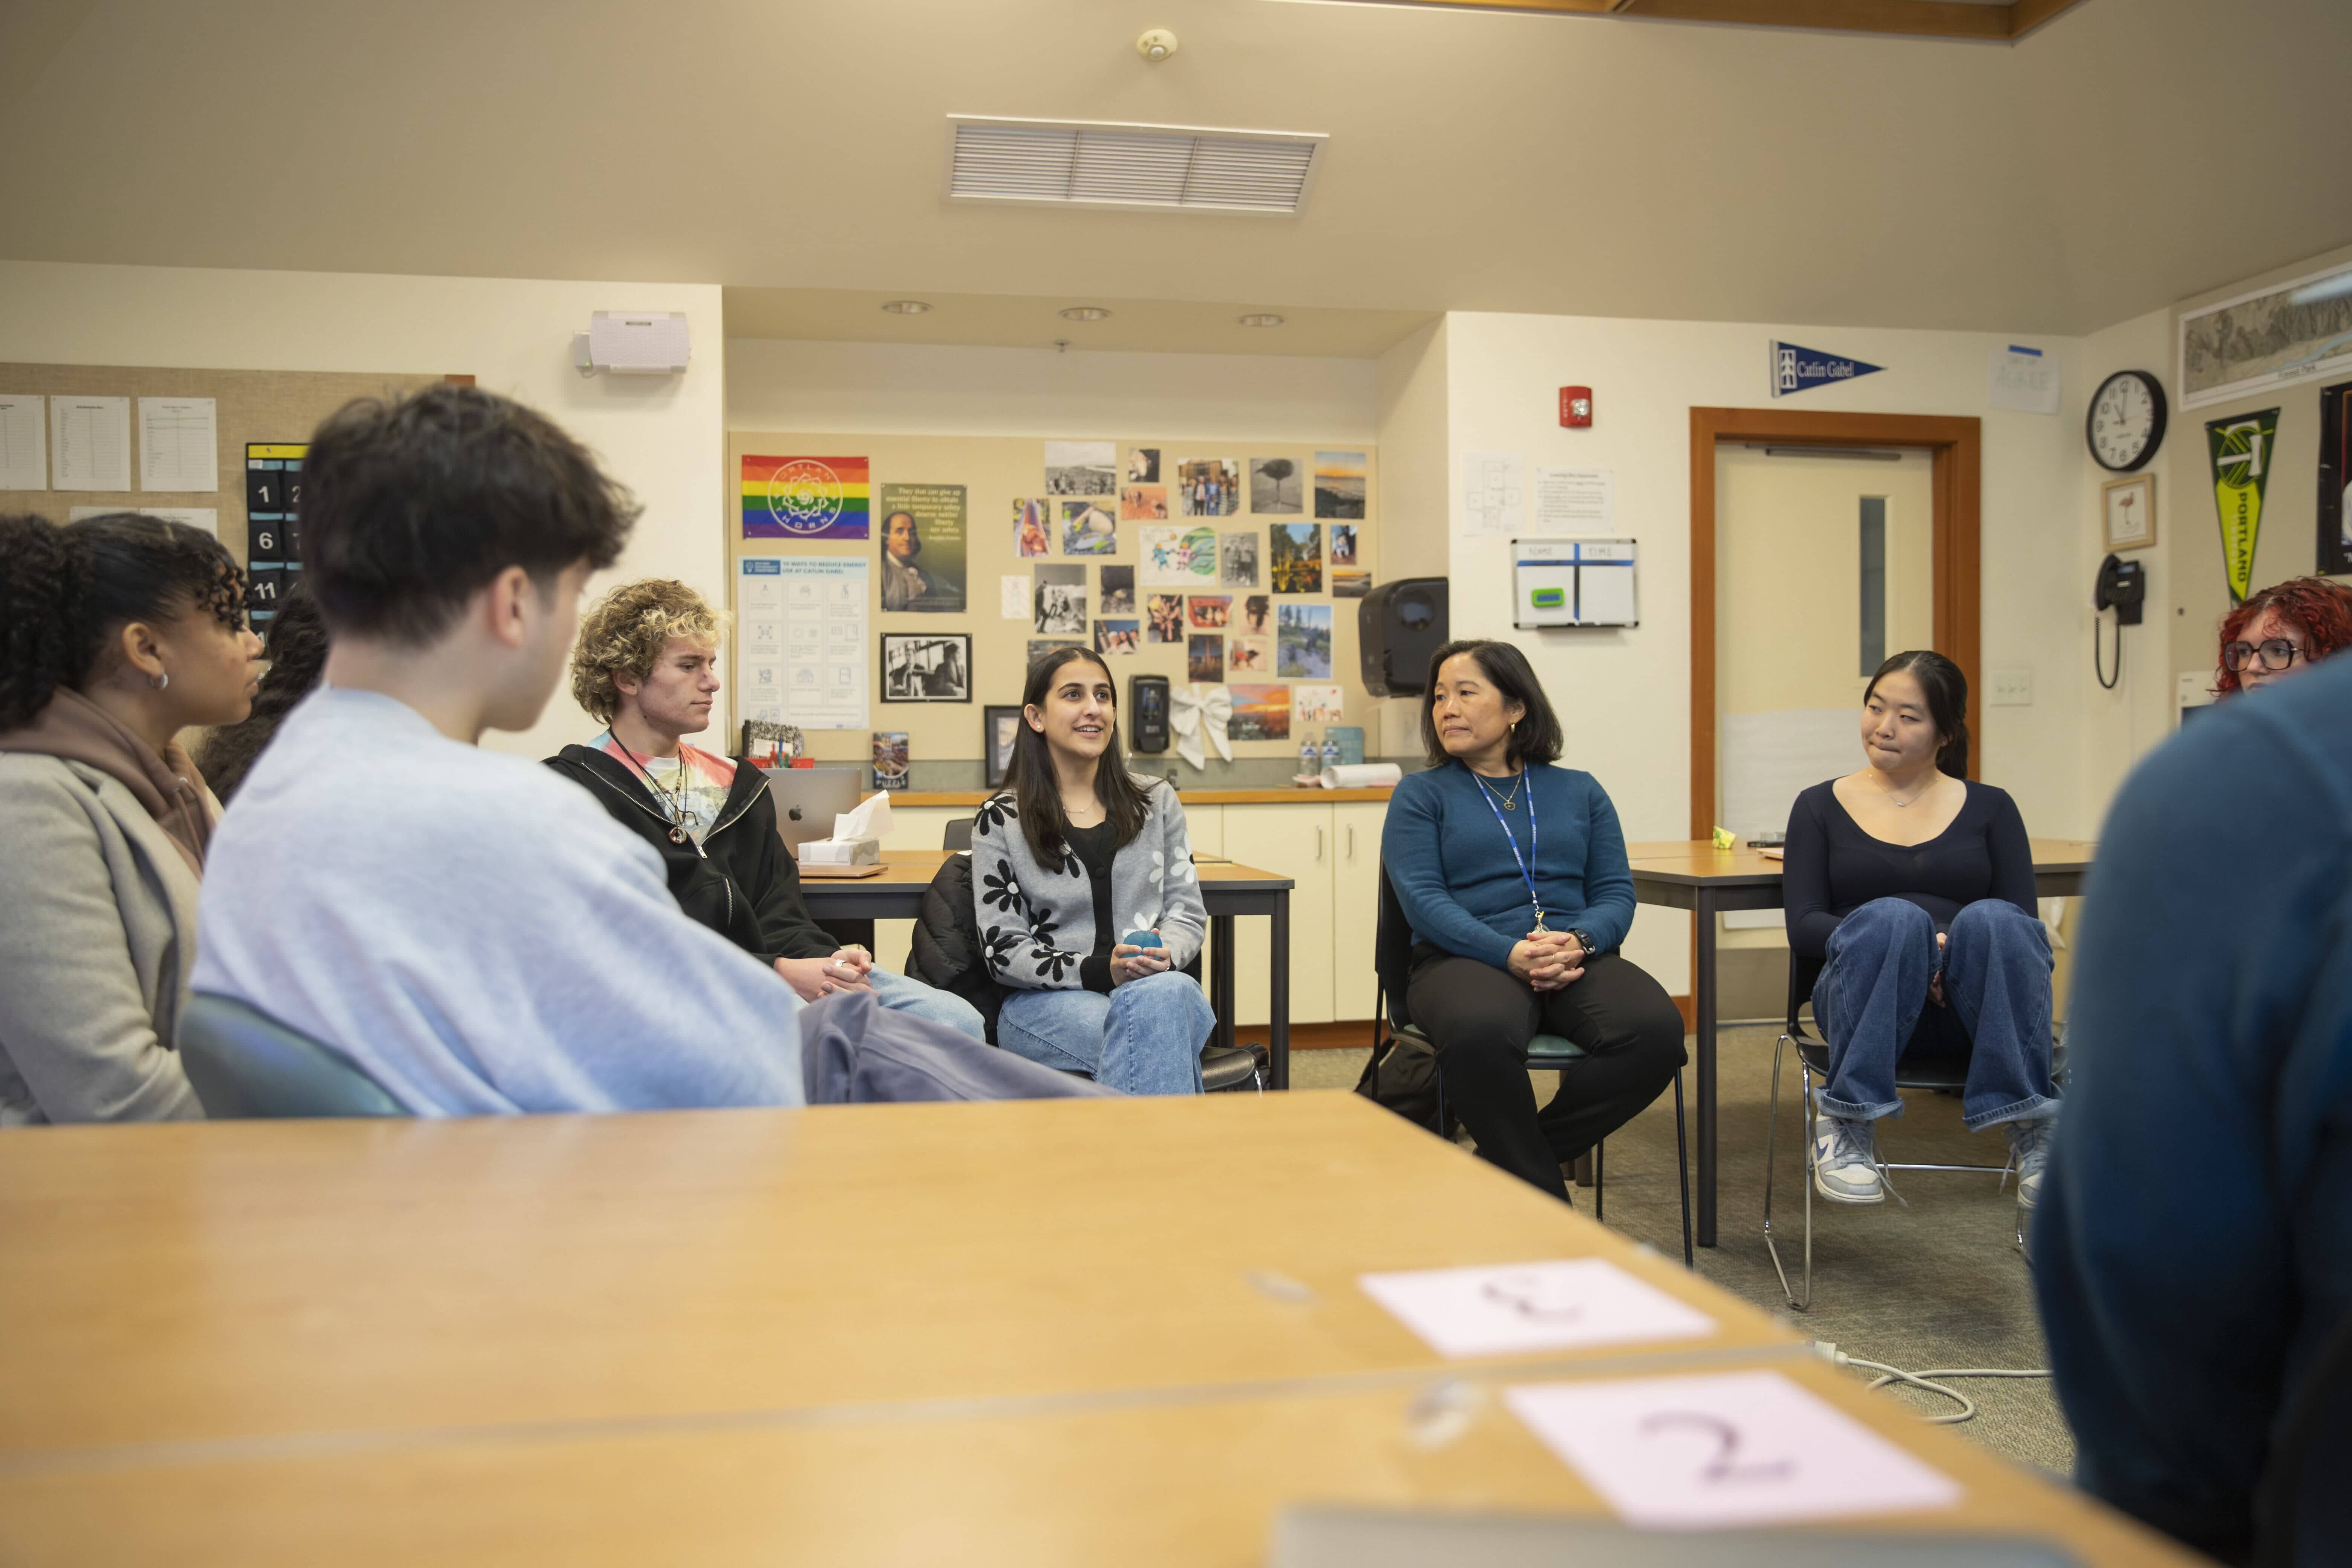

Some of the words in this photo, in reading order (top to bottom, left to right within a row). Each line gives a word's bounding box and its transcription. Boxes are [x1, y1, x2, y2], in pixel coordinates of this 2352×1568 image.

[1797, 361, 1826, 377] Catlin
[1827, 361, 1854, 377] Gabel
[259, 486, 269, 503] 1
[292, 485, 301, 503] 2
[775, 507, 837, 529] THORNS
[259, 532, 273, 549] 6
[2238, 492, 2247, 582] PORTLAND
[254, 582, 276, 599] 11
[1638, 1408, 1800, 1483] 2
